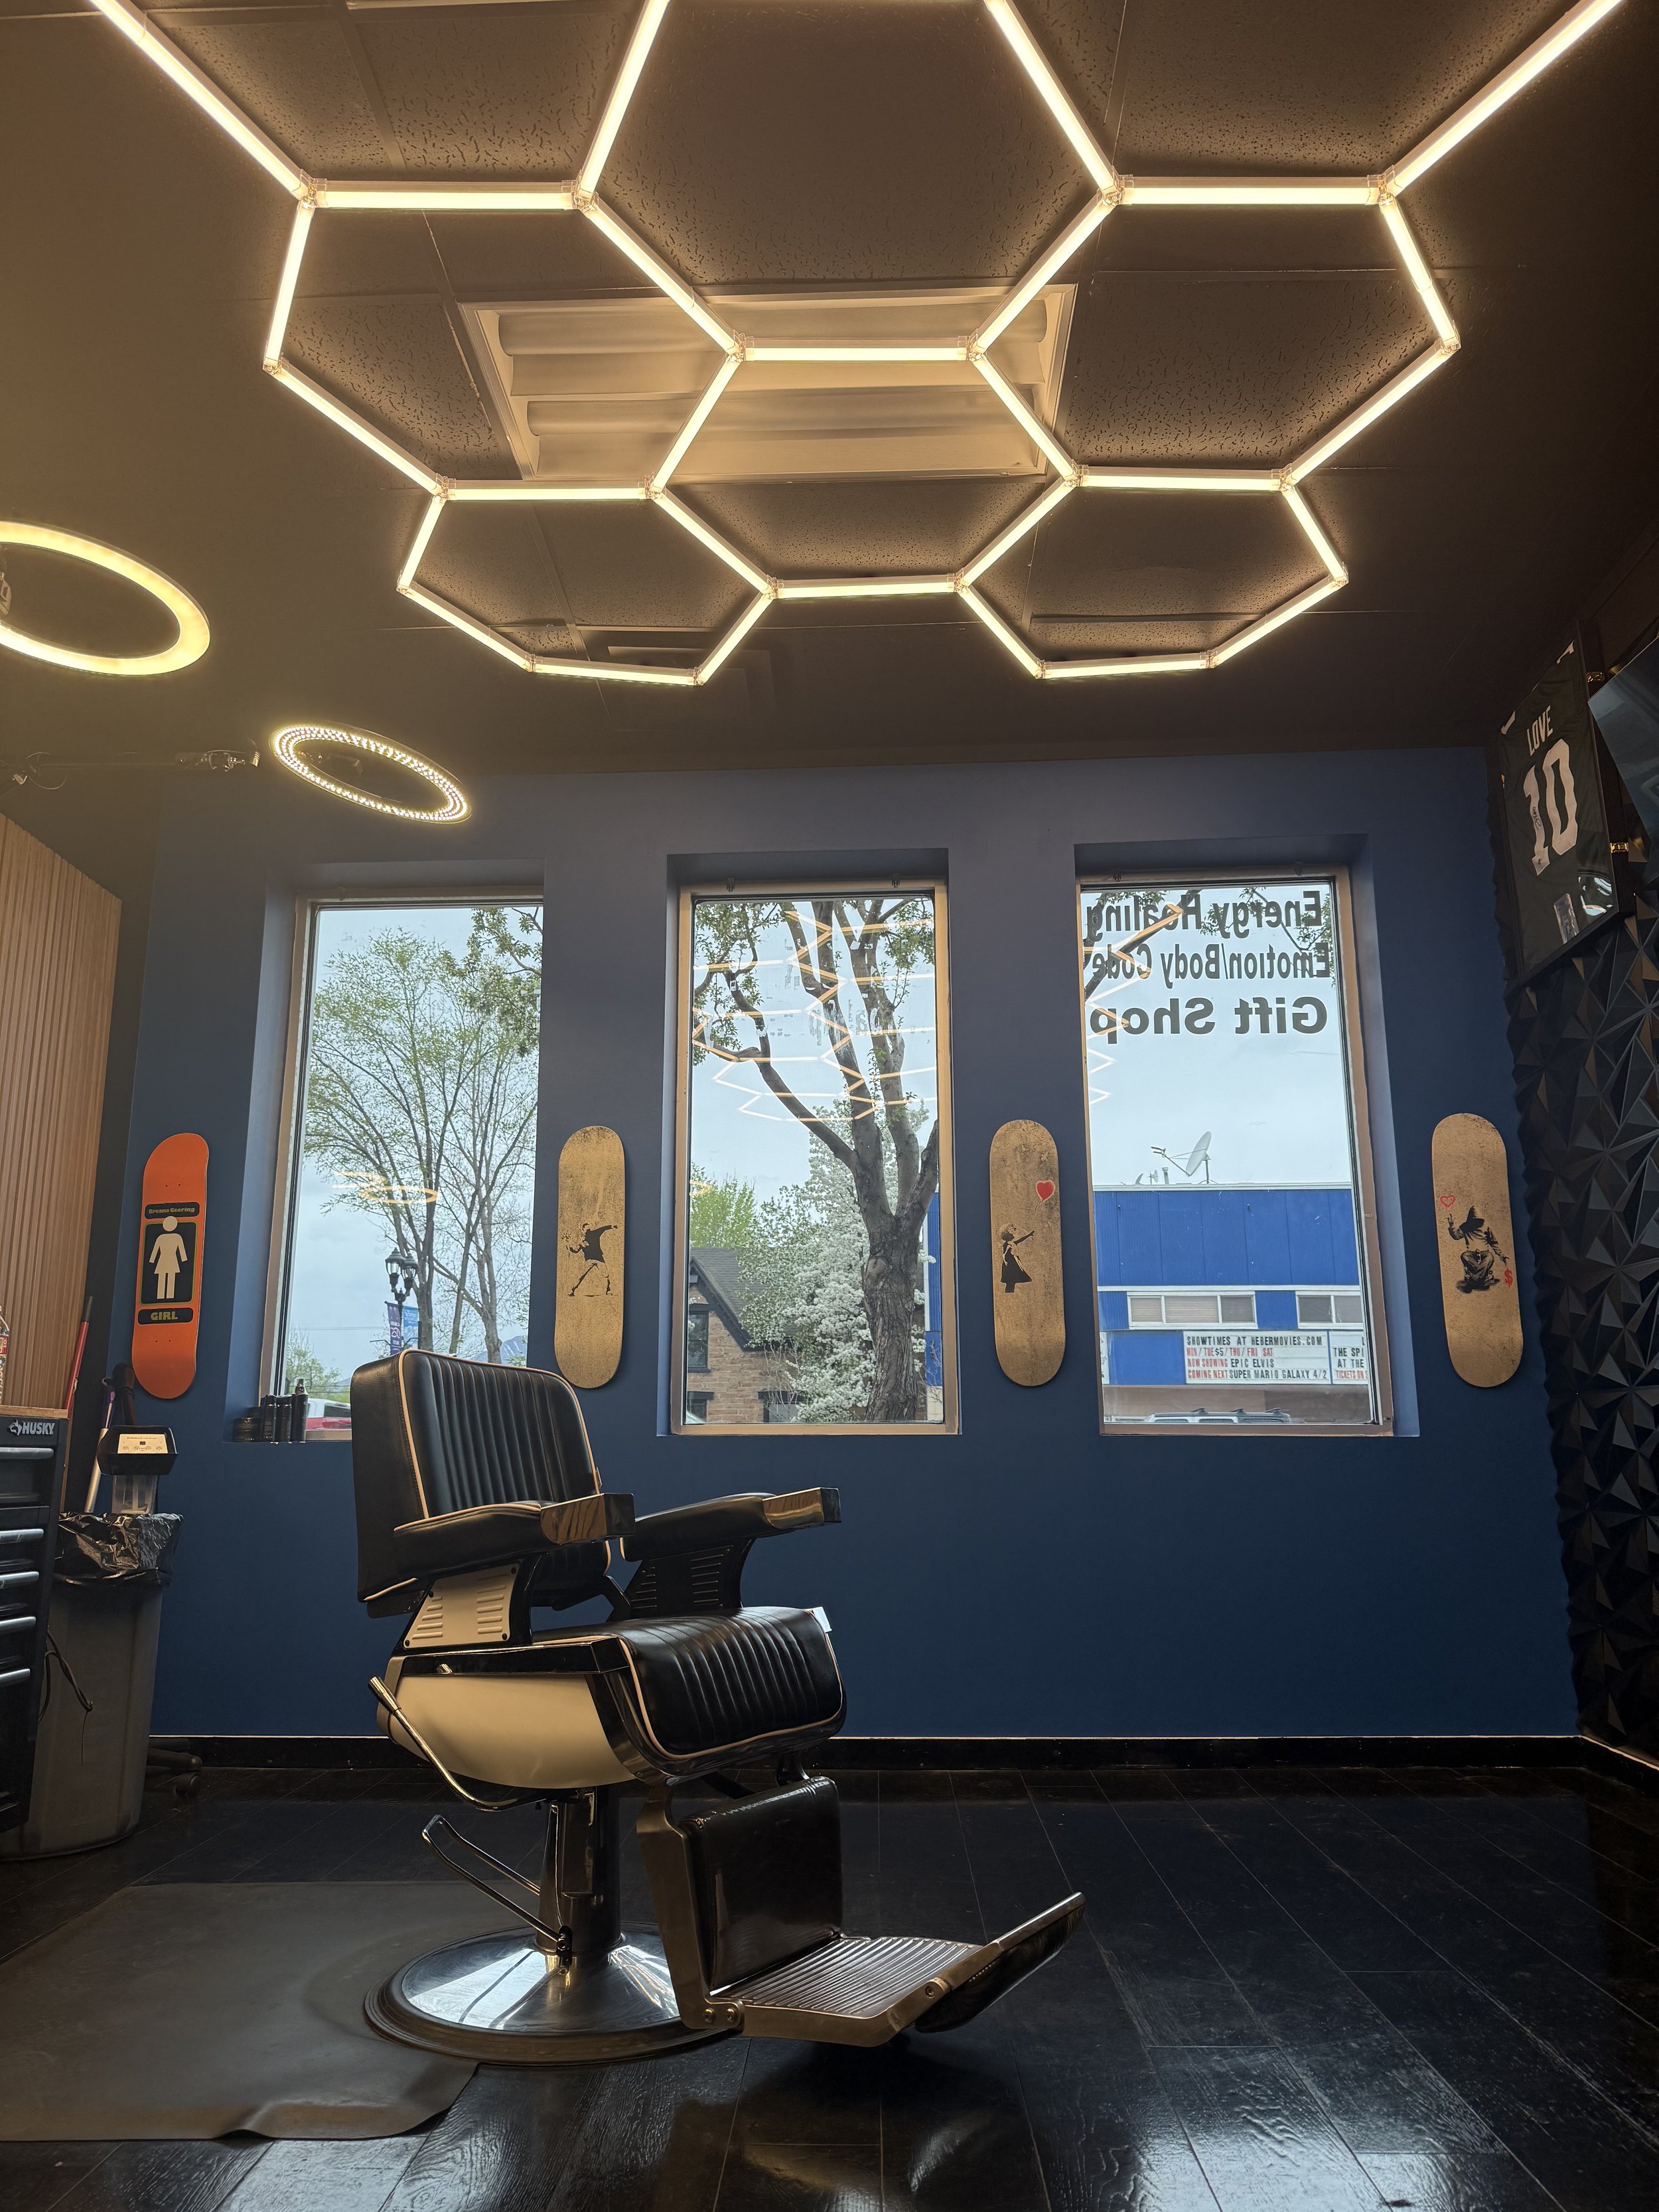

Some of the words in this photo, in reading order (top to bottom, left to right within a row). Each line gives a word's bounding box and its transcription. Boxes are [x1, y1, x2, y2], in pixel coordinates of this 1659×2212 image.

[1527, 705, 1553, 756] LOVE
[1523, 738, 1577, 876] 10
[150, 1311, 179, 1321] GIRL
[1187, 1336, 1231, 1345] SHOWTIMES
[1237, 1336, 1246, 1345] AT
[1252, 1336, 1323, 1345] HEBERMOVIES.COM
[1263, 1348, 1273, 1357] SAT
[1333, 1347, 1347, 1357] THE
[1188, 1359, 1200, 1367] NOW
[1202, 1359, 1228, 1367] SHOWING
[1231, 1359, 1248, 1368] EPIC
[1253, 1359, 1274, 1368] ELVIS
[1338, 1359, 1346, 1368] AT
[1351, 1359, 1364, 1368] THE
[1188, 1370, 1211, 1378] COMING
[1213, 1370, 1228, 1378] NEXT
[1230, 1370, 1251, 1378] SUPER
[1254, 1370, 1279, 1378] MARIO
[1282, 1370, 1309, 1378] GALAXY
[1314, 1370, 1327, 1379] 4/2
[1336, 1370, 1356, 1379] TICKETS
[1357, 1370, 1364, 1379] ON
[22, 1422, 55, 1435] HUSKY
